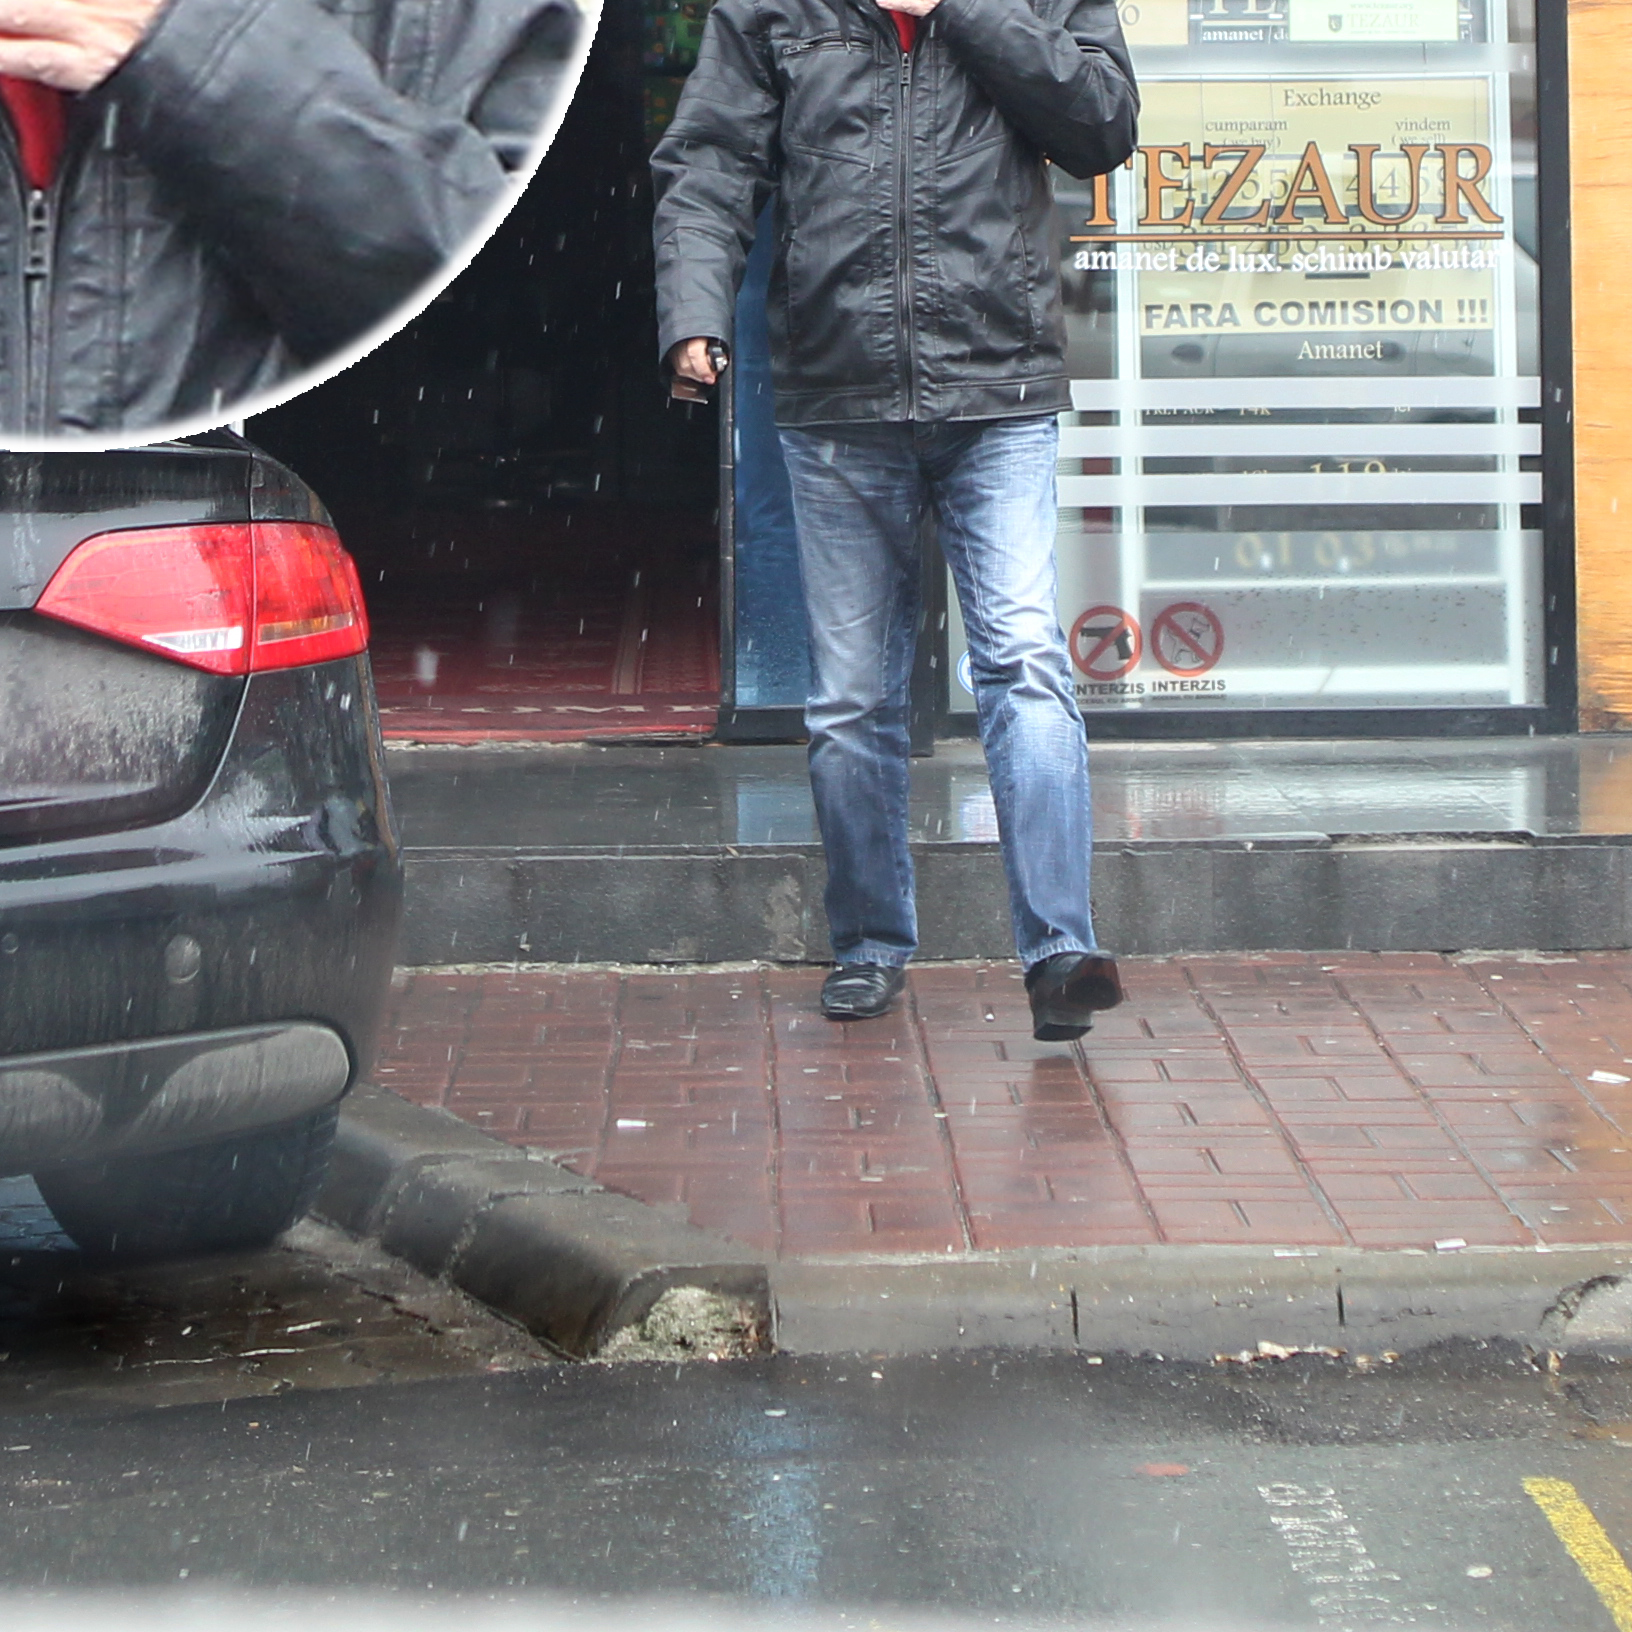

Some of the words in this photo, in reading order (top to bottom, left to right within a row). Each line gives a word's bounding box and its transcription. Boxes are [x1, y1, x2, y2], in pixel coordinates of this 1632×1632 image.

[1346, 13, 1421, 29] TEZAUR
[1201, 26, 1265, 42] amanet
[1282, 87, 1382, 111] Exchange
[1204, 119, 1288, 134] cumparam
[1394, 117, 1451, 132] vindem
[1073, 245, 1179, 273] amanet
[1184, 244, 1221, 272] de
[1228, 245, 1283, 273] lux.
[1290, 243, 1393, 273] schimb
[1398, 243, 1502, 271] valutar
[1143, 300, 1241, 330] FARA
[1253, 297, 1444, 328] COMISION
[1296, 340, 1385, 362] Amanet
[1073, 681, 1146, 697] INTERZIS
[1151, 678, 1227, 693] INTERZIS
